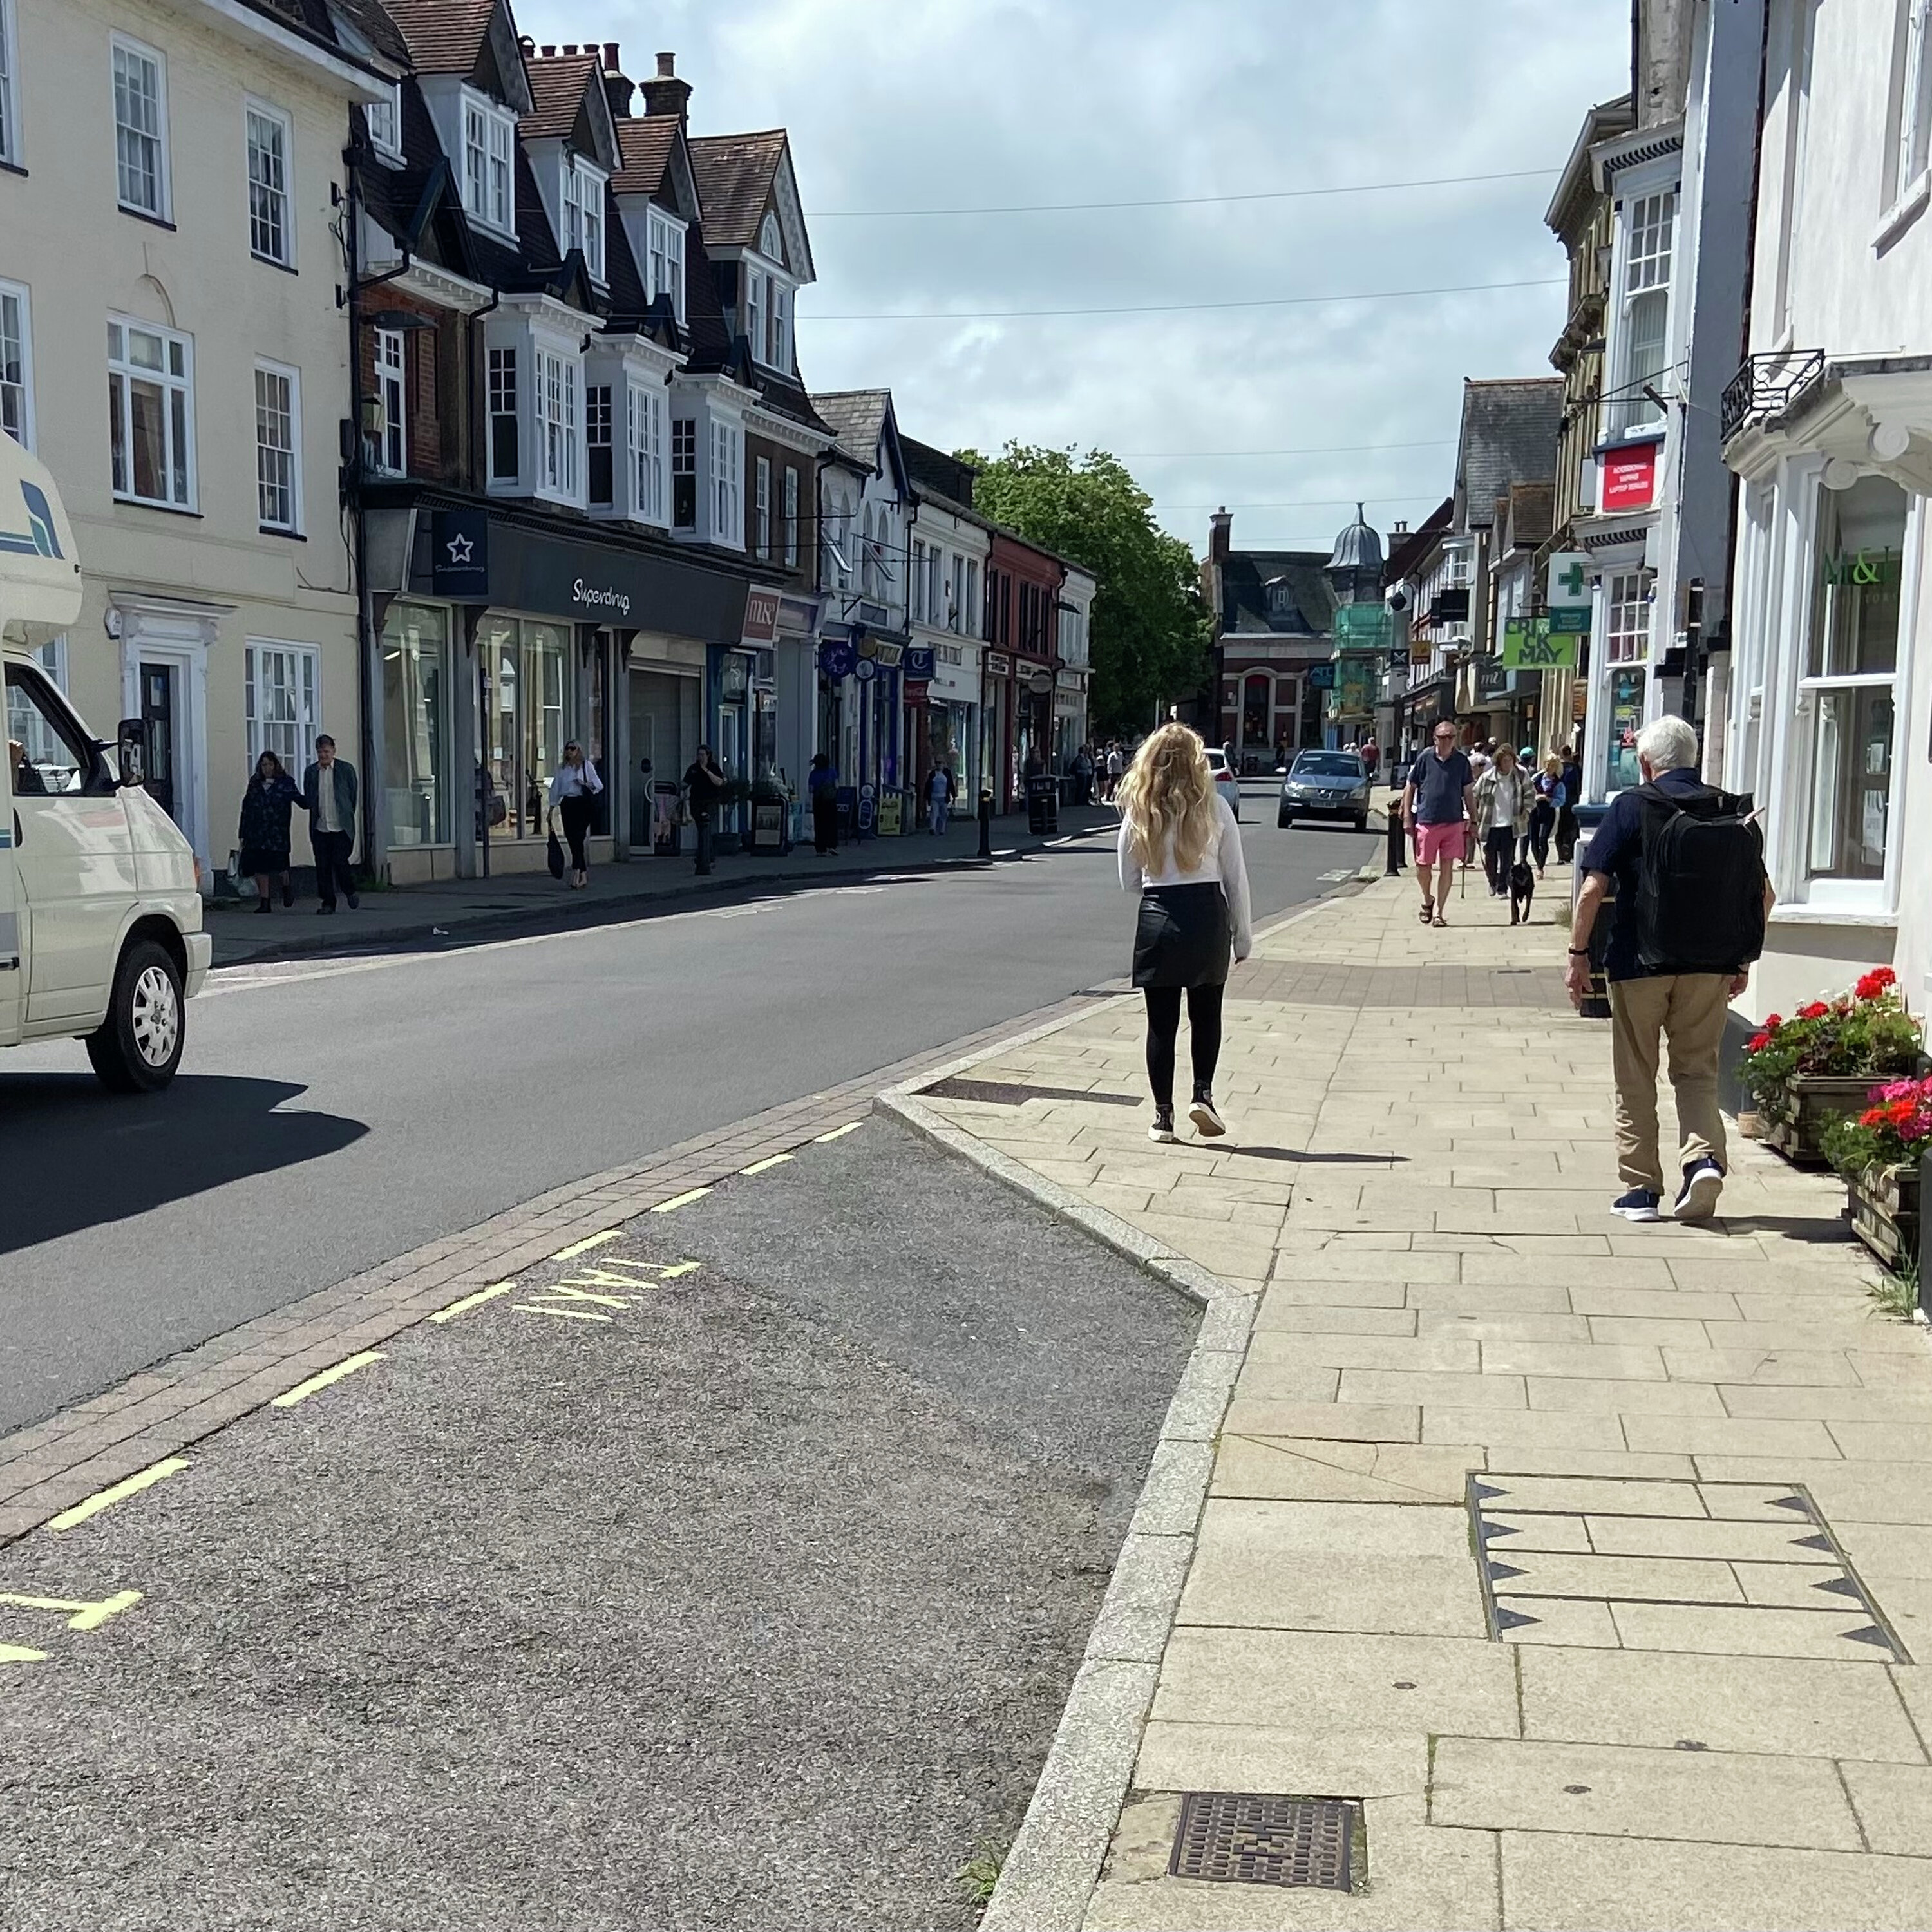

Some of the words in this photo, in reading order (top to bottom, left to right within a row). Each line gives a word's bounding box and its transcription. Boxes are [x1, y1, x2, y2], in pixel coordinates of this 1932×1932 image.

[1853, 550, 1880, 585] &
[573, 578, 630, 616] Superdrug
[1519, 647, 1564, 664] MAY
